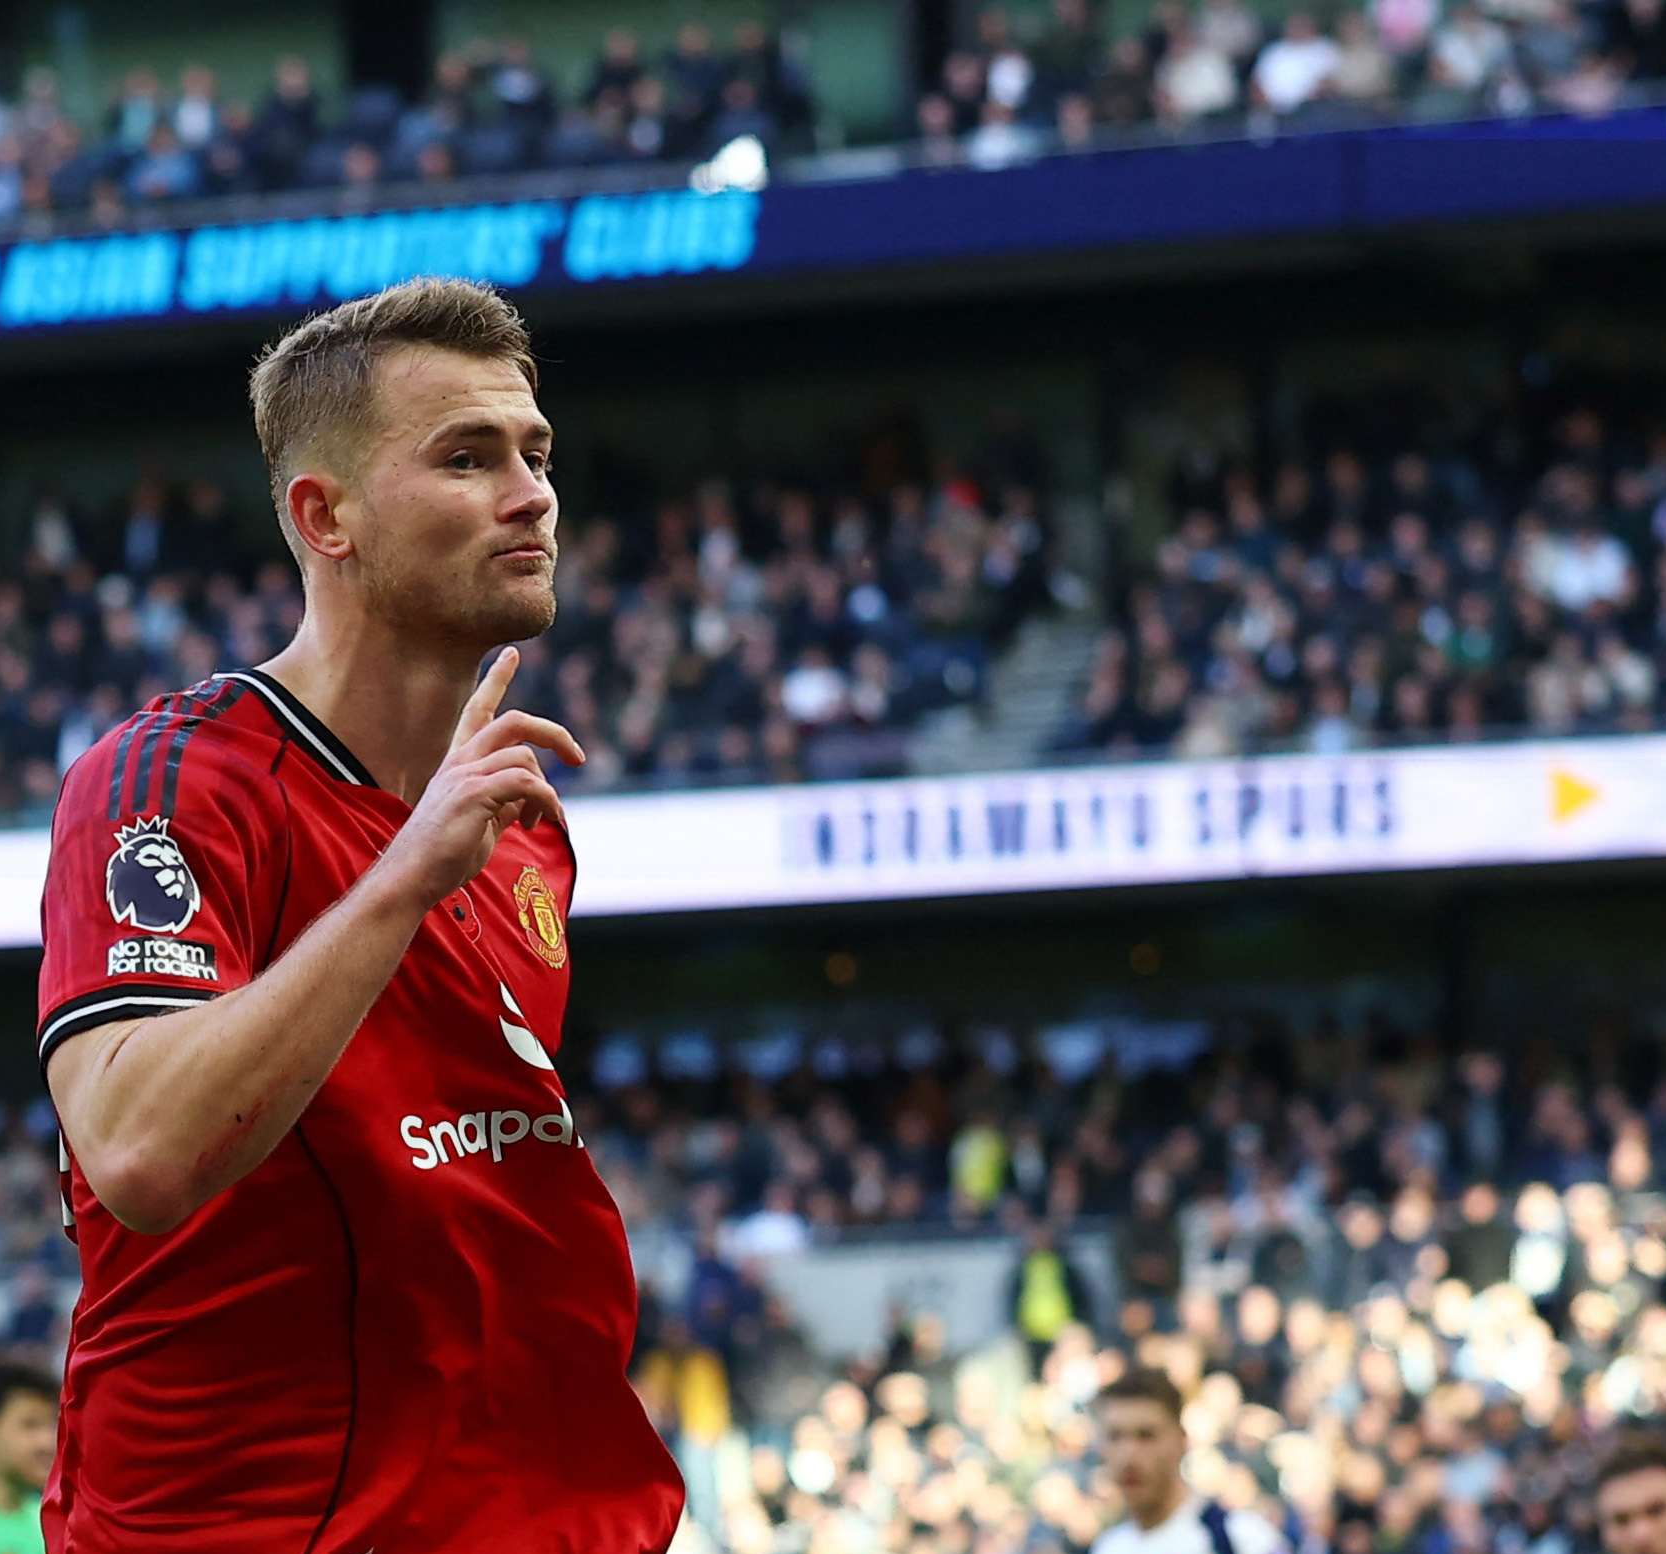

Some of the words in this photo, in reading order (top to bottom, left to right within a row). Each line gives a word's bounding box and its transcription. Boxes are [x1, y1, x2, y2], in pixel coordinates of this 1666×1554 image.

[0, 231, 180, 327] ASIAN
[564, 187, 759, 283] CLUBS
[1191, 776, 1395, 846] SPURS
[108, 939, 140, 961] No
[144, 940, 205, 964] room
[144, 957, 219, 981] racism
[400, 1097, 584, 1170] Snapd
